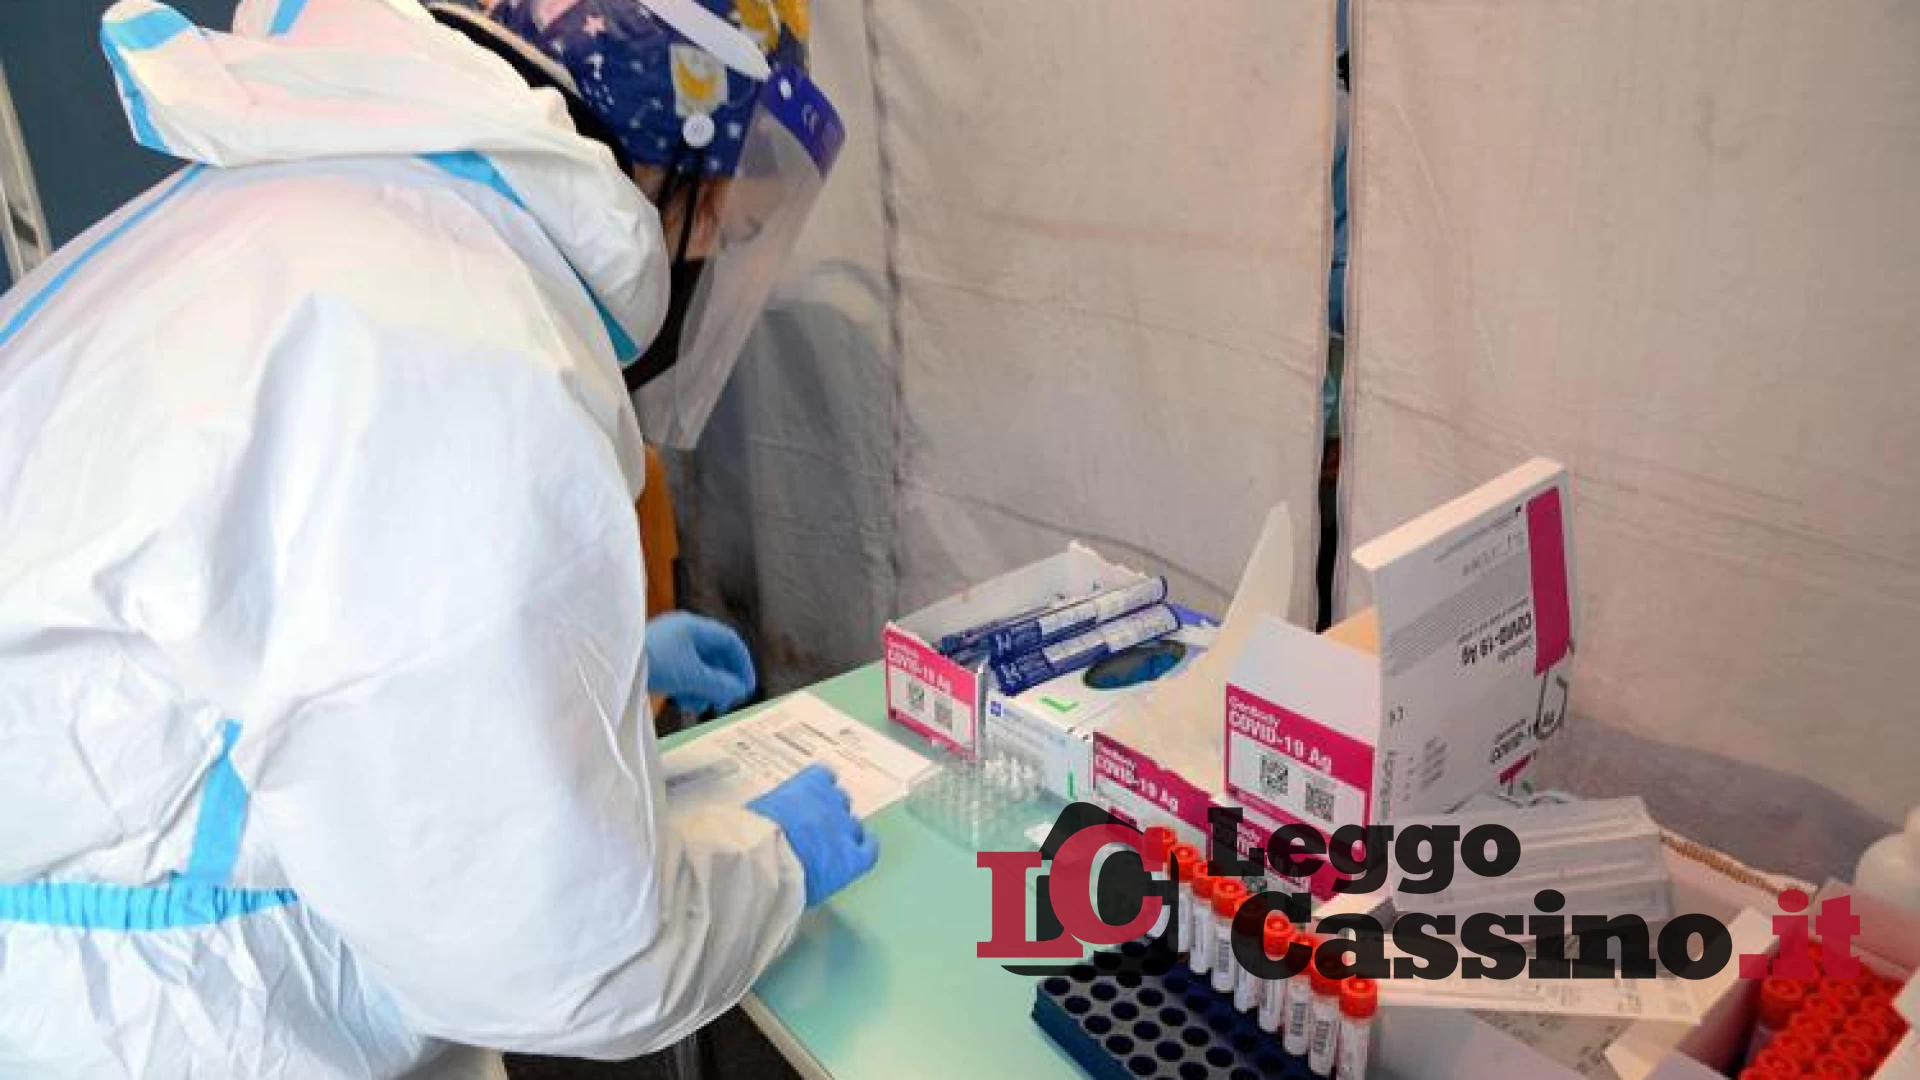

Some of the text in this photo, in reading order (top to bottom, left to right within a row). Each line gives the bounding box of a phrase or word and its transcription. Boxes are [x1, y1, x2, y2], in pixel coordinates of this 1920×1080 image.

[1228, 710, 1332, 776] COVID-19 Ag
[1095, 754, 1158, 798] COVID-19
